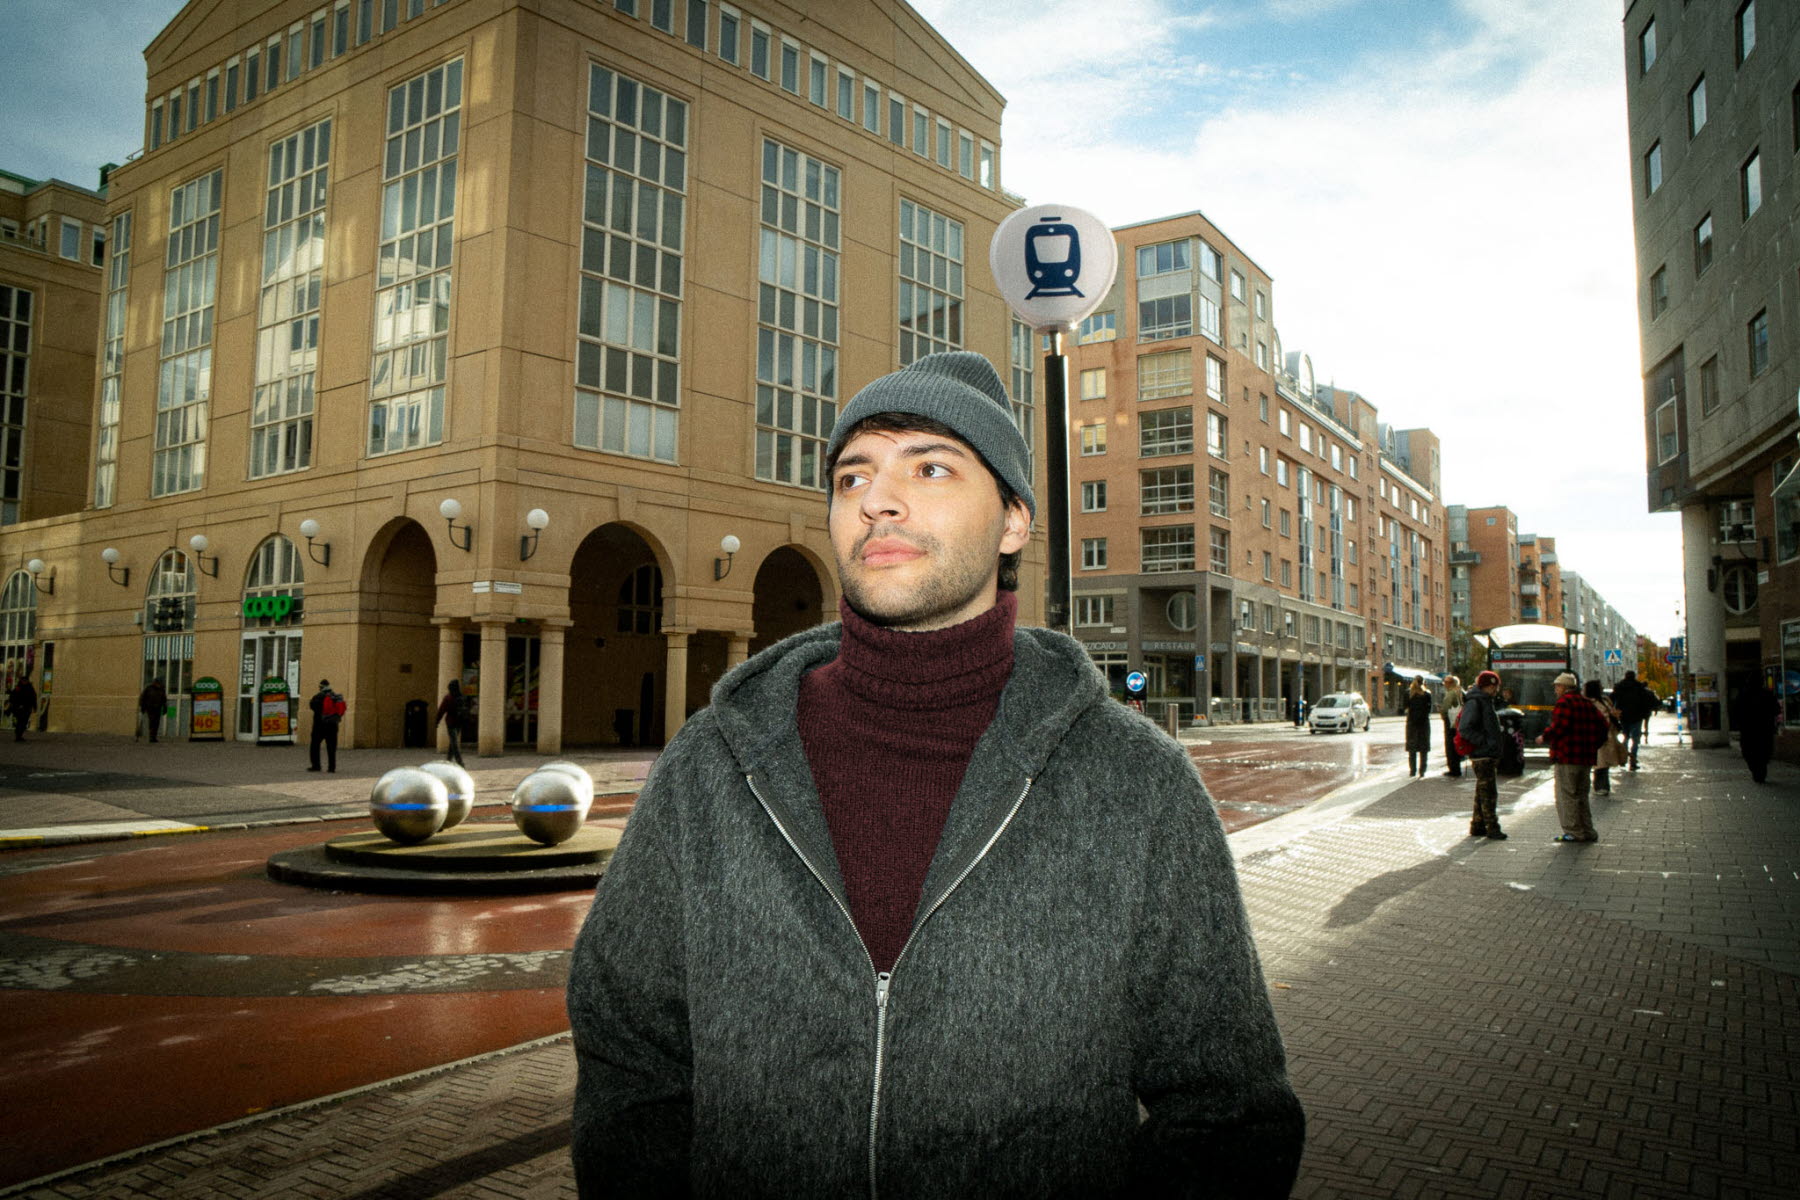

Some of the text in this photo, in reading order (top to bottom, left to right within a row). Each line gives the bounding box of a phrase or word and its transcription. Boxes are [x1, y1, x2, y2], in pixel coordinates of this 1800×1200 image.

[243, 595, 293, 622] coop
[195, 682, 219, 690] coop
[263, 682, 286, 690] coop
